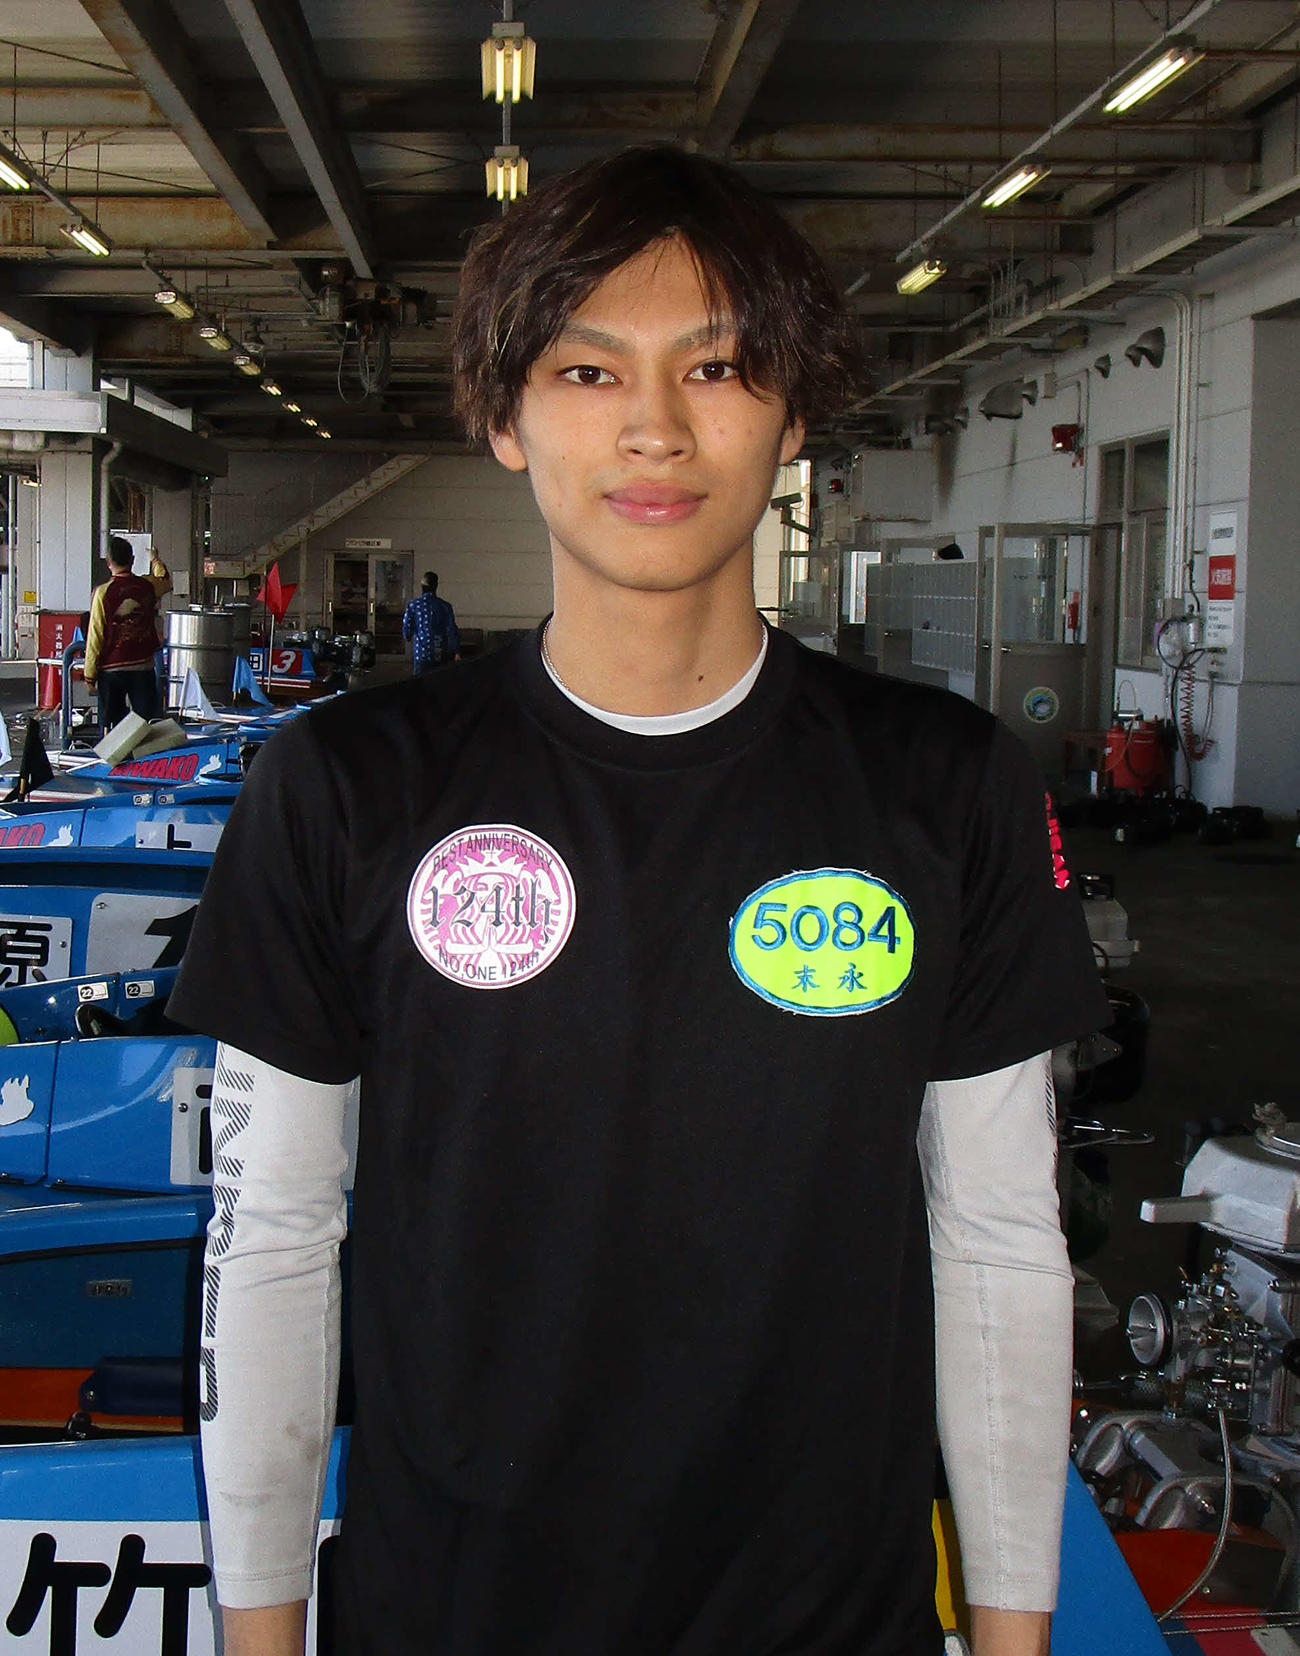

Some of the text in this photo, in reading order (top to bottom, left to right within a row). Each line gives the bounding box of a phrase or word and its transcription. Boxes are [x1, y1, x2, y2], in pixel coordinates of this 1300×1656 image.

[272, 650, 297, 674] 3
[433, 832, 553, 876] BEST ANNIVERSARY
[427, 878, 554, 945] 124th
[751, 901, 901, 954] 5084
[791, 962, 868, 993] 末永
